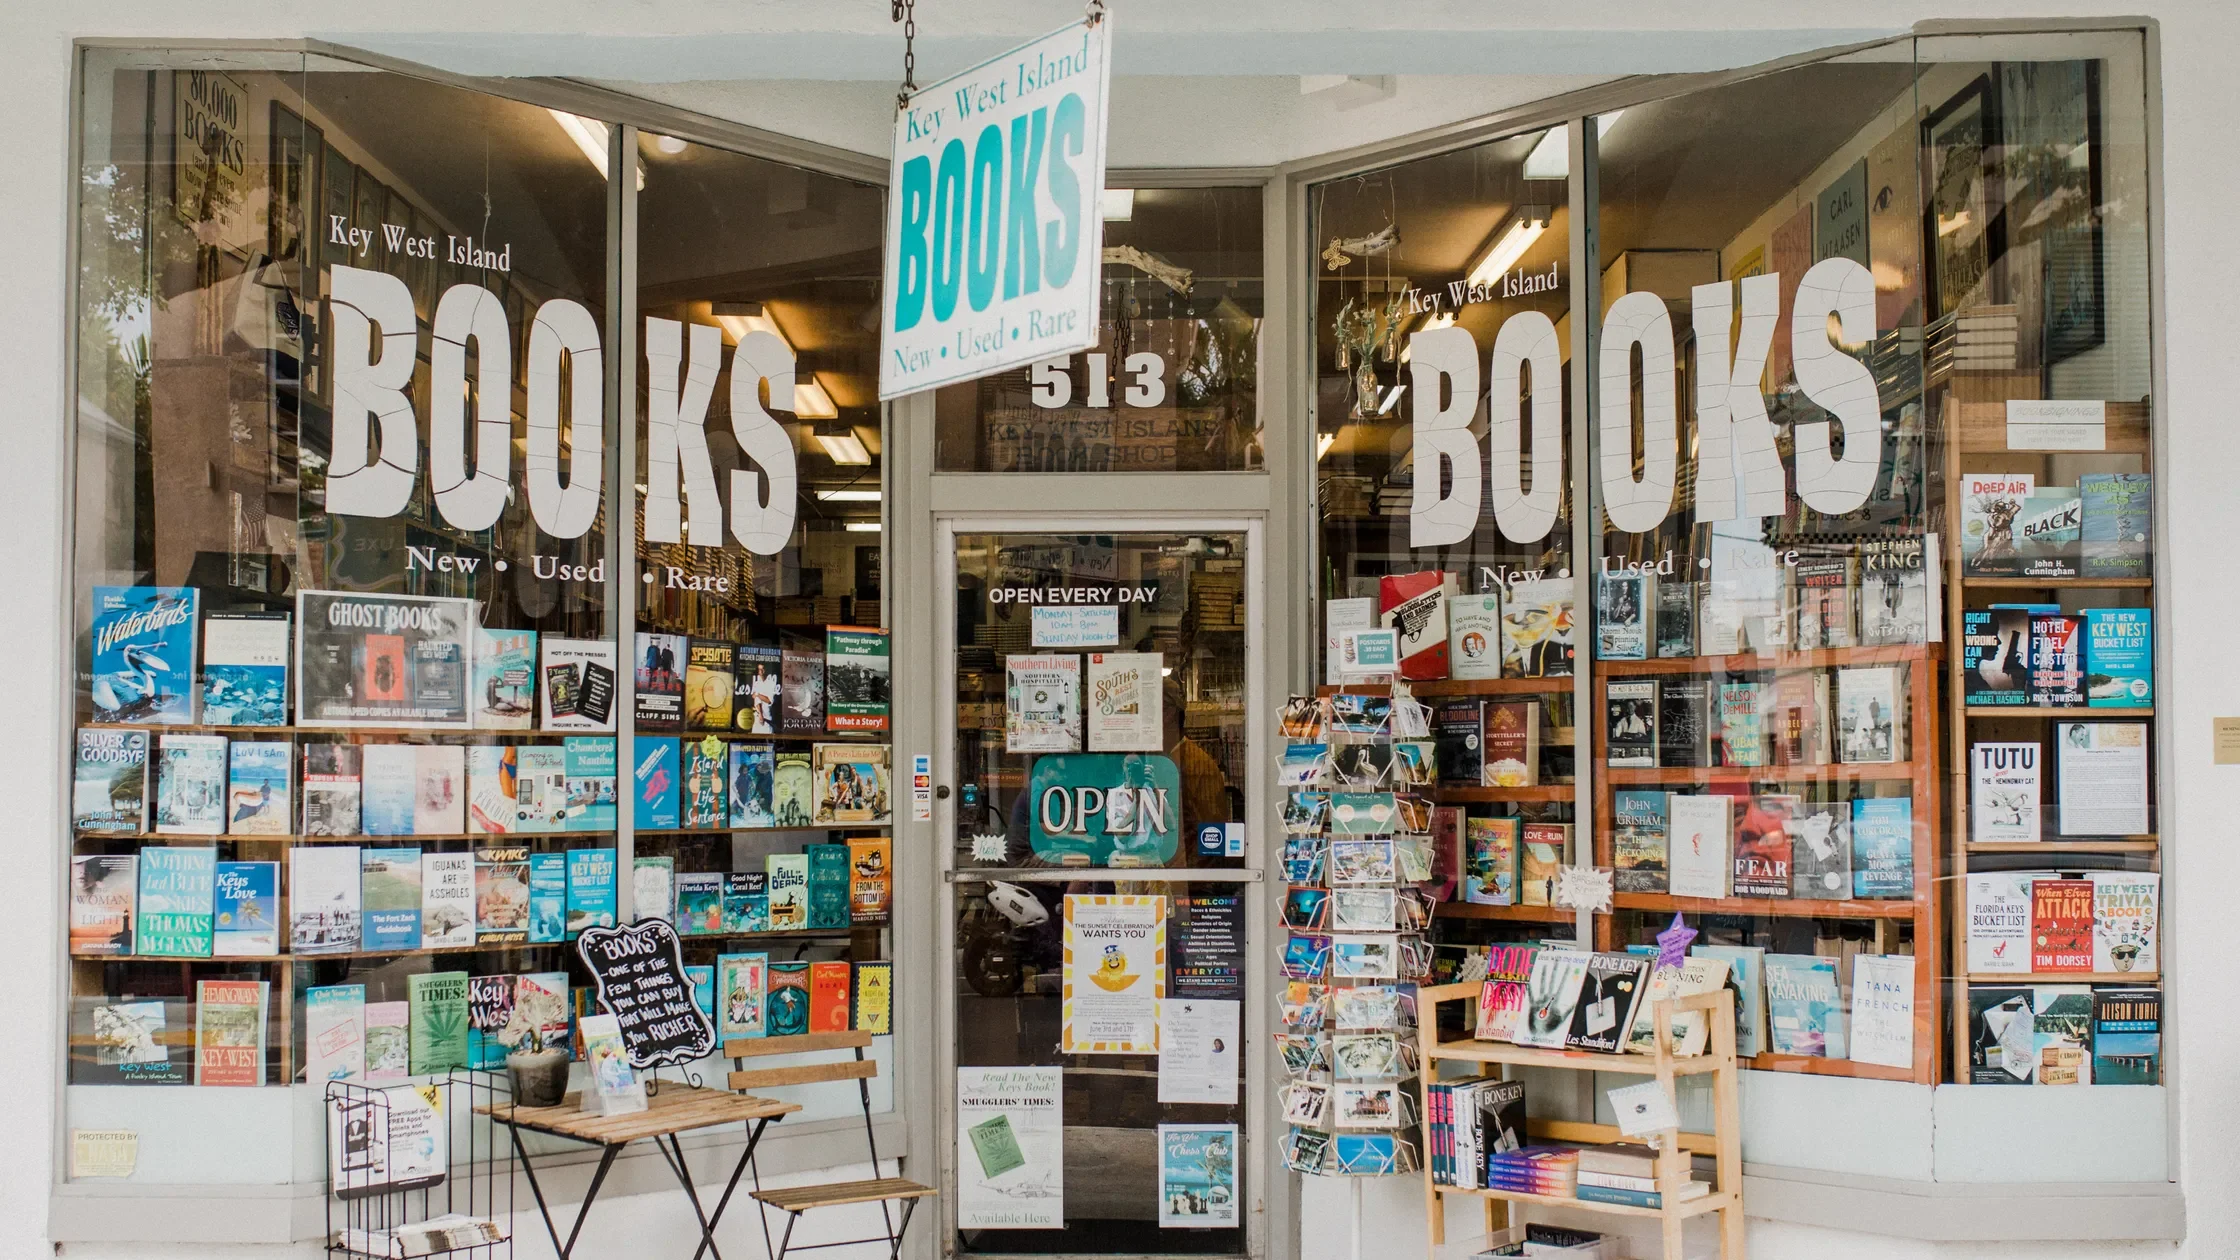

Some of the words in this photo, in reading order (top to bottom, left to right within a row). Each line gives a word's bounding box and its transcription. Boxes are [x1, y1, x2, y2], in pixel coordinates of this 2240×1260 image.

[906, 107, 946, 144] Key
[954, 79, 1007, 122] West
[1015, 34, 1089, 97] Island
[894, 92, 1086, 333] BOOKS
[1830, 189, 1854, 222] CARL
[329, 215, 373, 255] Key
[383, 223, 436, 260] West
[448, 234, 511, 273] Island
[1821, 219, 1862, 262] HIAASEN
[1409, 285, 1441, 316] Key
[1447, 277, 1492, 308] West
[1502, 261, 1559, 299] Island
[893, 344, 933, 377] New
[956, 323, 1005, 361] Used
[1028, 306, 1077, 343] Rare
[1031, 352, 1166, 408] 513
[325, 263, 798, 556] BOOKS
[1409, 257, 1882, 548] BOOKS
[1124, 419, 1224, 439] ISLAND
[2024, 507, 2078, 537] BLACK
[1866, 540, 1921, 551] STEPHEN
[1867, 551, 1921, 571] KING
[2092, 558, 2108, 566] R.K.
[2110, 558, 2144, 567] Simpson
[405, 546, 480, 573] New
[532, 555, 606, 583] Used
[665, 566, 730, 594] Rare
[1480, 565, 1545, 590] New
[1598, 554, 1675, 580] Used
[2024, 567, 2075, 576] Cunningham
[989, 588, 1043, 603] OPEN
[1049, 587, 1113, 603] EVERY
[1118, 587, 1158, 603] DAY
[329, 602, 382, 628] GHOST
[388, 604, 442, 631] BOOKS
[1033, 607, 1073, 621] MONDAY
[1965, 613, 1992, 624] RIGHT
[2101, 614, 2117, 622] THE
[2119, 614, 2136, 622] NEW
[97, 598, 194, 656] Waterbirds
[1965, 624, 1977, 635] AS
[2033, 622, 2069, 634] HOTEL
[2092, 624, 2114, 637] KEY
[2116, 623, 2148, 637] WEST
[1965, 635, 1998, 646] WRONG
[2033, 637, 2065, 650] FIDEL
[2094, 638, 2125, 648] BUCKET
[2126, 638, 2145, 648] LIST
[691, 647, 732, 662] SPYGATE
[1965, 647, 1982, 657] CAN
[1008, 658, 1048, 670] Southern
[1050, 657, 1077, 672] Living
[1965, 658, 1976, 669] BE
[2033, 653, 2078, 666] CASTRO
[1723, 690, 1757, 701] NELSON
[835, 717, 855, 725] What
[862, 718, 883, 727] Story!
[1439, 710, 1479, 721] BLOODLINE
[82, 733, 124, 748] SILVER
[1981, 747, 2035, 770] TUTU
[1981, 777, 1992, 785] THE
[2024, 777, 2035, 785] CAT
[695, 787, 716, 809] Life
[1625, 797, 1651, 811] JOHN
[1039, 786, 1169, 837] OPEN
[79, 819, 136, 831] Cunningham
[1616, 813, 1661, 826] GRISHAM
[1524, 831, 1541, 839] LOVE
[1547, 832, 1563, 840] RUIN
[432, 860, 467, 871] IGUANAS
[571, 863, 588, 875] KEY
[590, 862, 613, 874] WEST
[1735, 859, 1788, 878] FEAR
[216, 873, 248, 887] Keys
[442, 874, 457, 884] ARE
[750, 874, 762, 883] Night
[777, 867, 795, 880] FULL
[1862, 870, 1903, 882] REVENGE
[772, 875, 803, 889] BEANS
[856, 881, 871, 892] FROM
[873, 881, 884, 892] THE
[2097, 885, 2120, 893] KEY
[2121, 885, 2155, 893] WEST
[430, 887, 469, 899] ASSHOLES
[854, 892, 876, 903] BOTTOM
[877, 891, 887, 902] UP
[2036, 888, 2062, 898] When
[2064, 887, 2091, 898] Elves
[2096, 894, 2154, 907] TRIVIA
[1975, 905, 2005, 914] FLORIDA
[2006, 905, 2025, 914] KEYS
[2036, 899, 2090, 919] ATTACK
[2107, 908, 2142, 917] BOOK
[145, 914, 210, 933] THOMAS
[1973, 915, 2005, 926] BUCKET
[2007, 915, 2026, 926] LIST
[1082, 930, 1122, 938] WANTS
[1124, 930, 1146, 938] YOU
[602, 930, 657, 960] BOOKS
[633, 962, 646, 973] OF
[648, 958, 669, 970] THE
[1591, 954, 1619, 971] BONE
[1620, 957, 1642, 973] KEY
[2036, 955, 2053, 966] TIM
[2056, 955, 2093, 966] DORSEY
[1766, 965, 1790, 981] SEA
[607, 982, 631, 997] FEW
[634, 973, 674, 991] THINGS
[1768, 982, 1829, 1002] KAYAKING
[1866, 981, 1901, 993] TANA
[419, 987, 465, 1001] TIMES:
[470, 980, 503, 1008] Key
[612, 998, 635, 1013] YOU
[637, 990, 660, 1005] CAN
[662, 985, 684, 1001] BUY
[1857, 1000, 1910, 1012] FRENCH
[2101, 1003, 2132, 1020] ALISON
[2134, 1003, 2158, 1020] LURIE
[618, 1012, 641, 1029] THAT
[639, 1006, 665, 1021] WILL
[664, 1001, 692, 1016] MAKE
[626, 1030, 649, 1046] YOU
[648, 1014, 704, 1042] RICHER
[982, 1073, 1008, 1082] Read
[1011, 1073, 1030, 1082] The
[1033, 1073, 1056, 1082] New
[969, 1213, 1020, 1224] Available
[1024, 1213, 1050, 1224] Here
